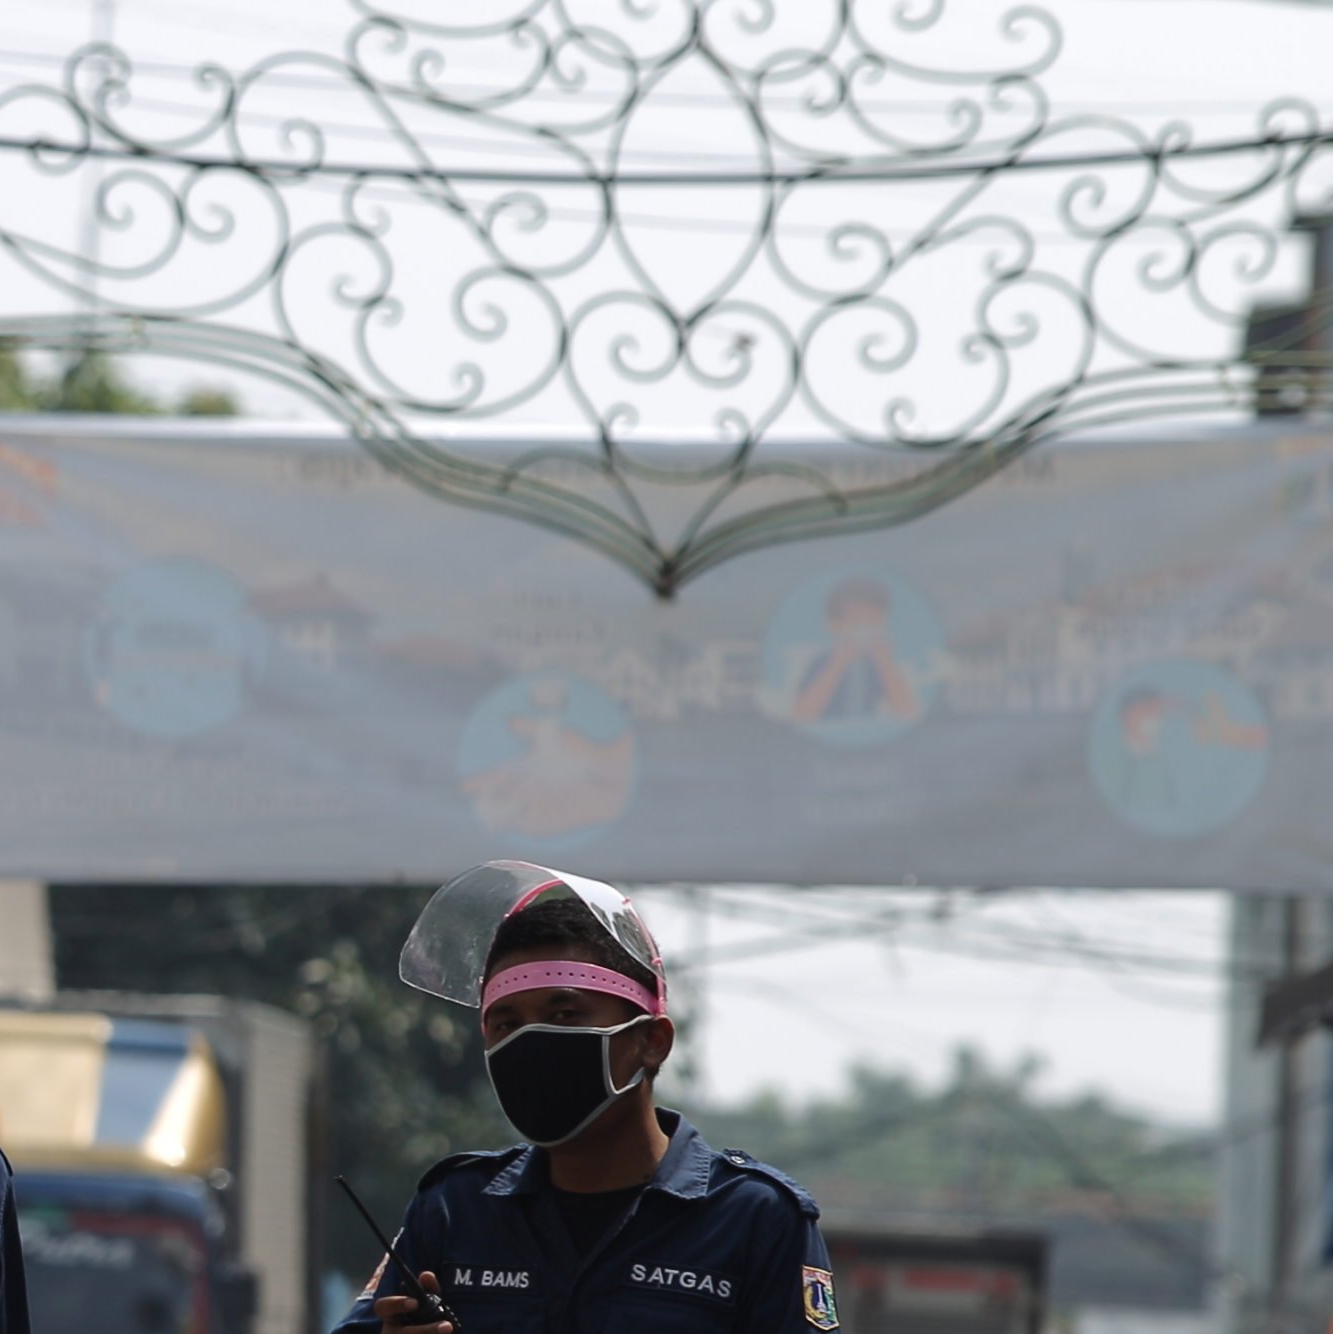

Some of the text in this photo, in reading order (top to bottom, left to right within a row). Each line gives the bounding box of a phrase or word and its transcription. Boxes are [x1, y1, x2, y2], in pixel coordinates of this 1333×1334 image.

[454, 1268, 529, 1288] M. BAMS
[631, 1264, 732, 1297] SATGAS
